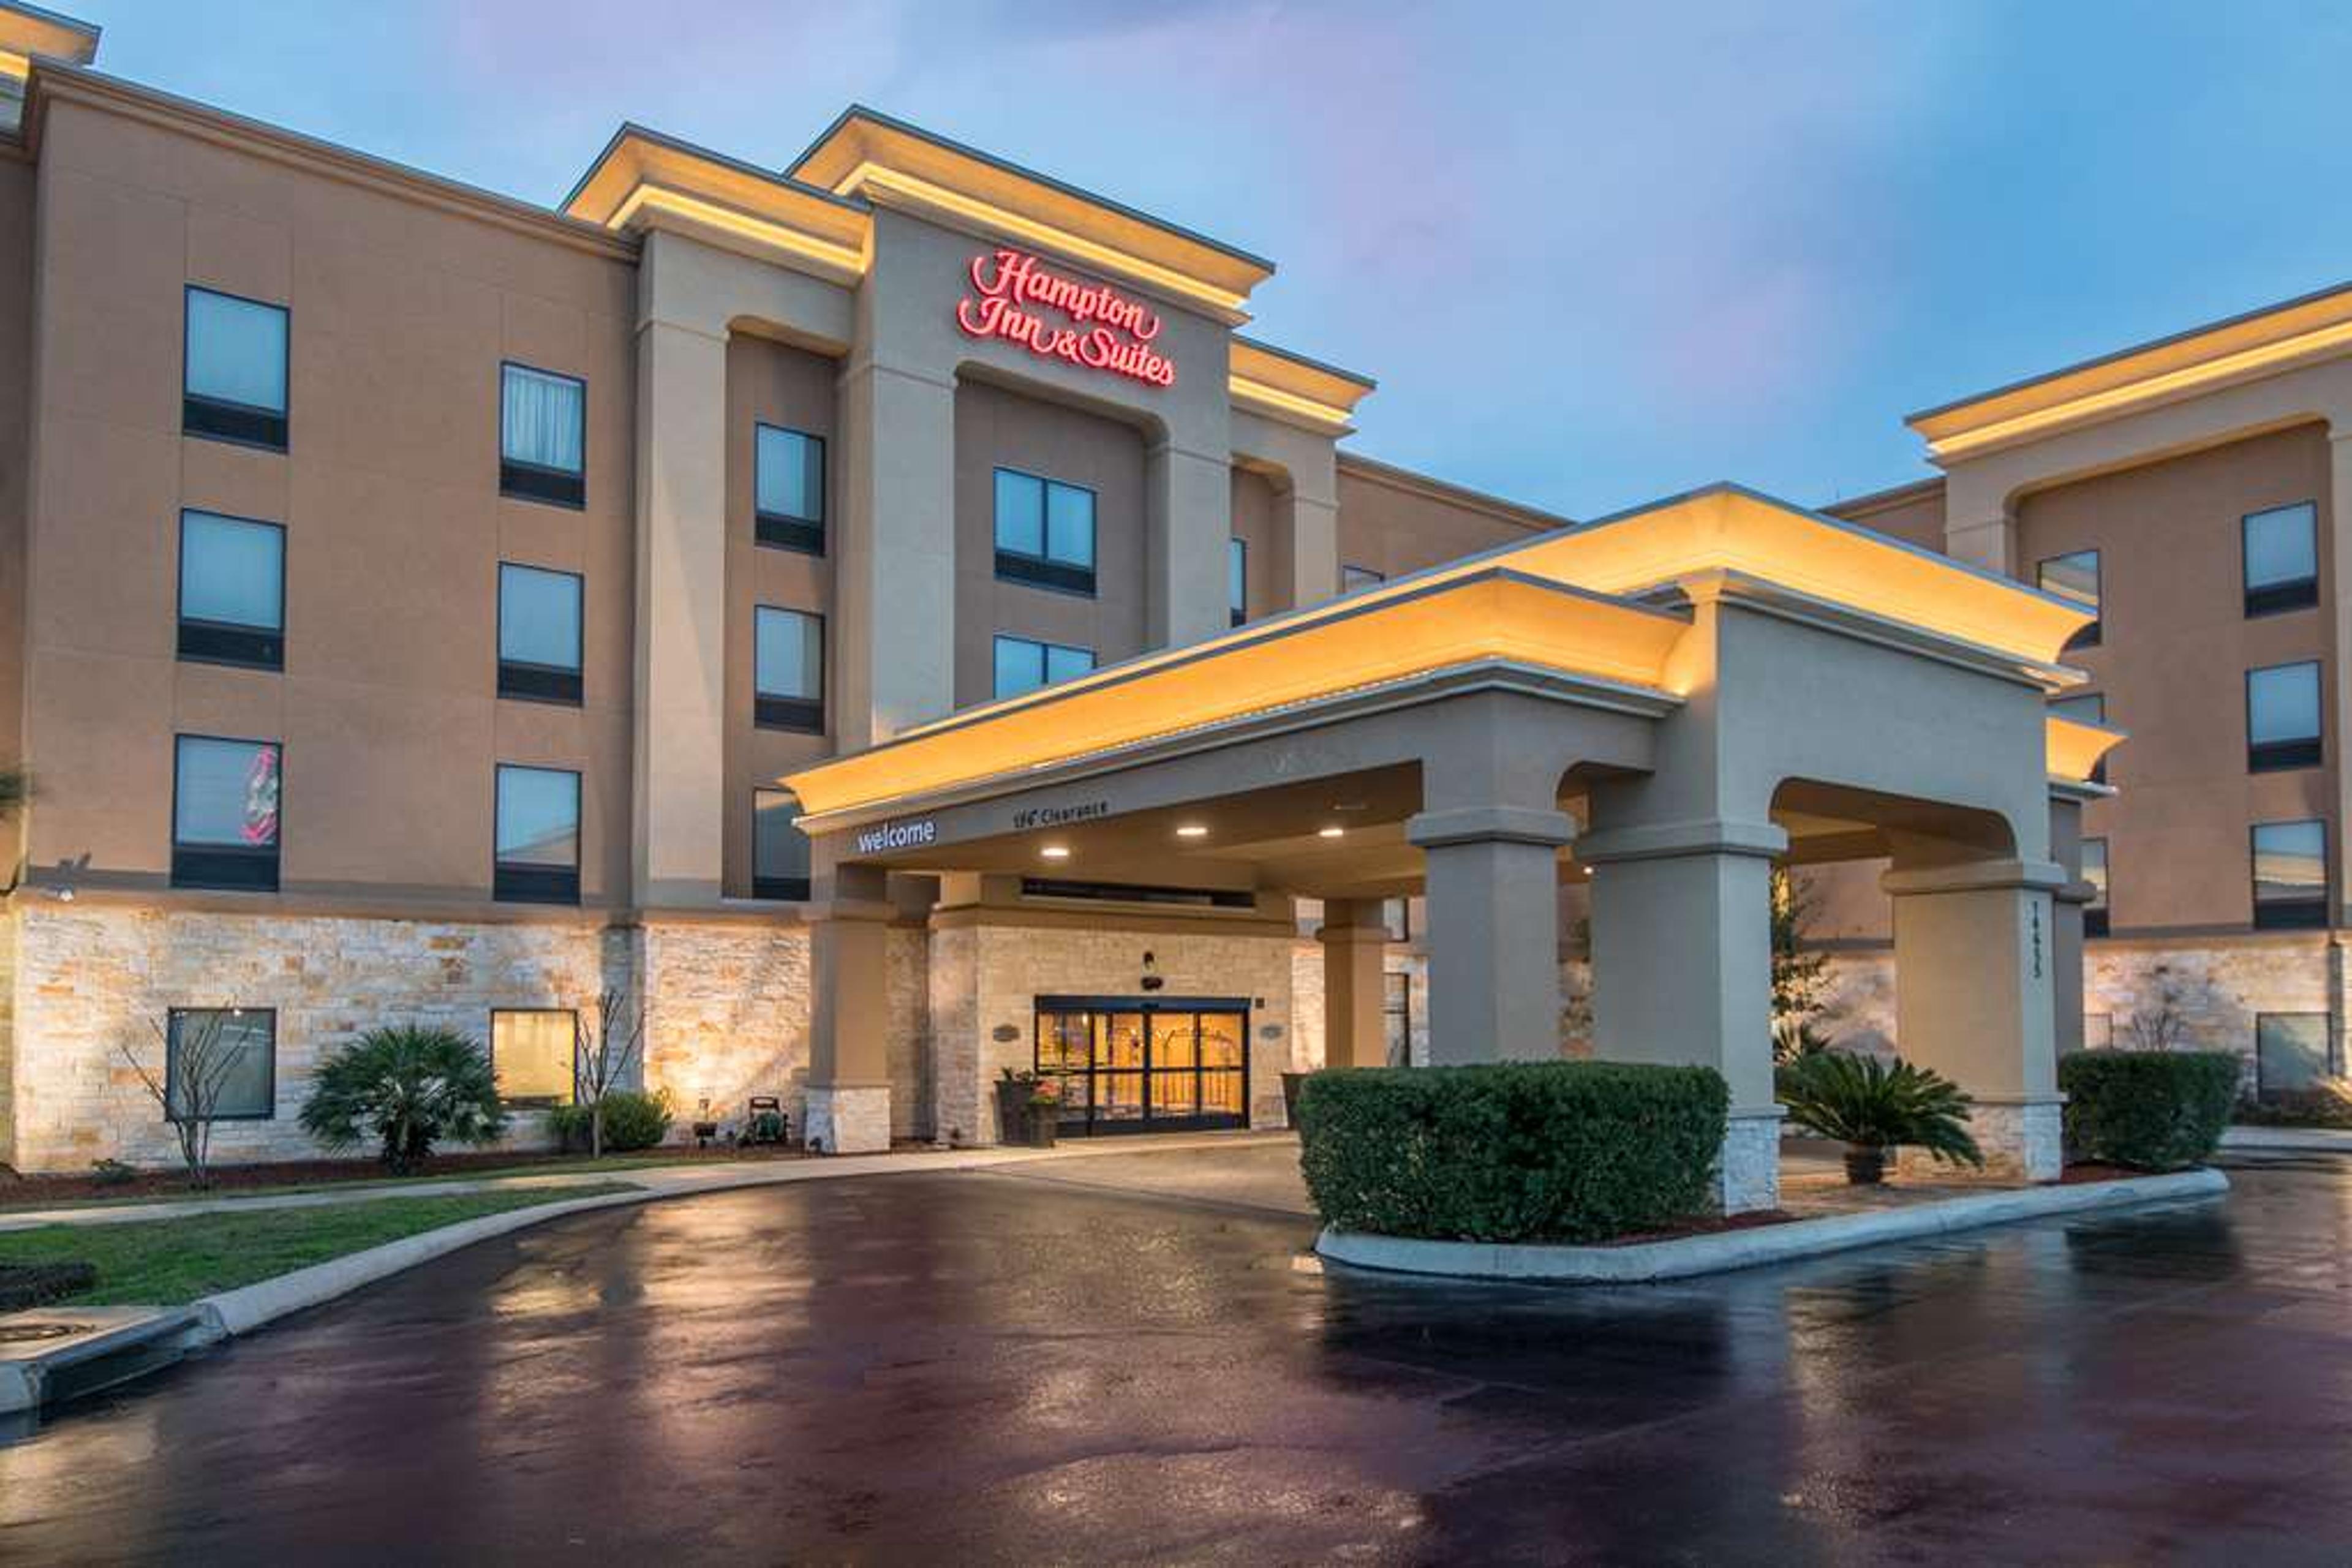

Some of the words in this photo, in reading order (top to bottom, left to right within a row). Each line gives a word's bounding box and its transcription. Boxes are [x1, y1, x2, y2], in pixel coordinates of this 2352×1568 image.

[970, 249, 1160, 339] Hampton
[957, 296, 1058, 353] Inn
[1057, 330, 1080, 363] &
[1079, 328, 1175, 387] Suites
[858, 820, 935, 852] welcome
